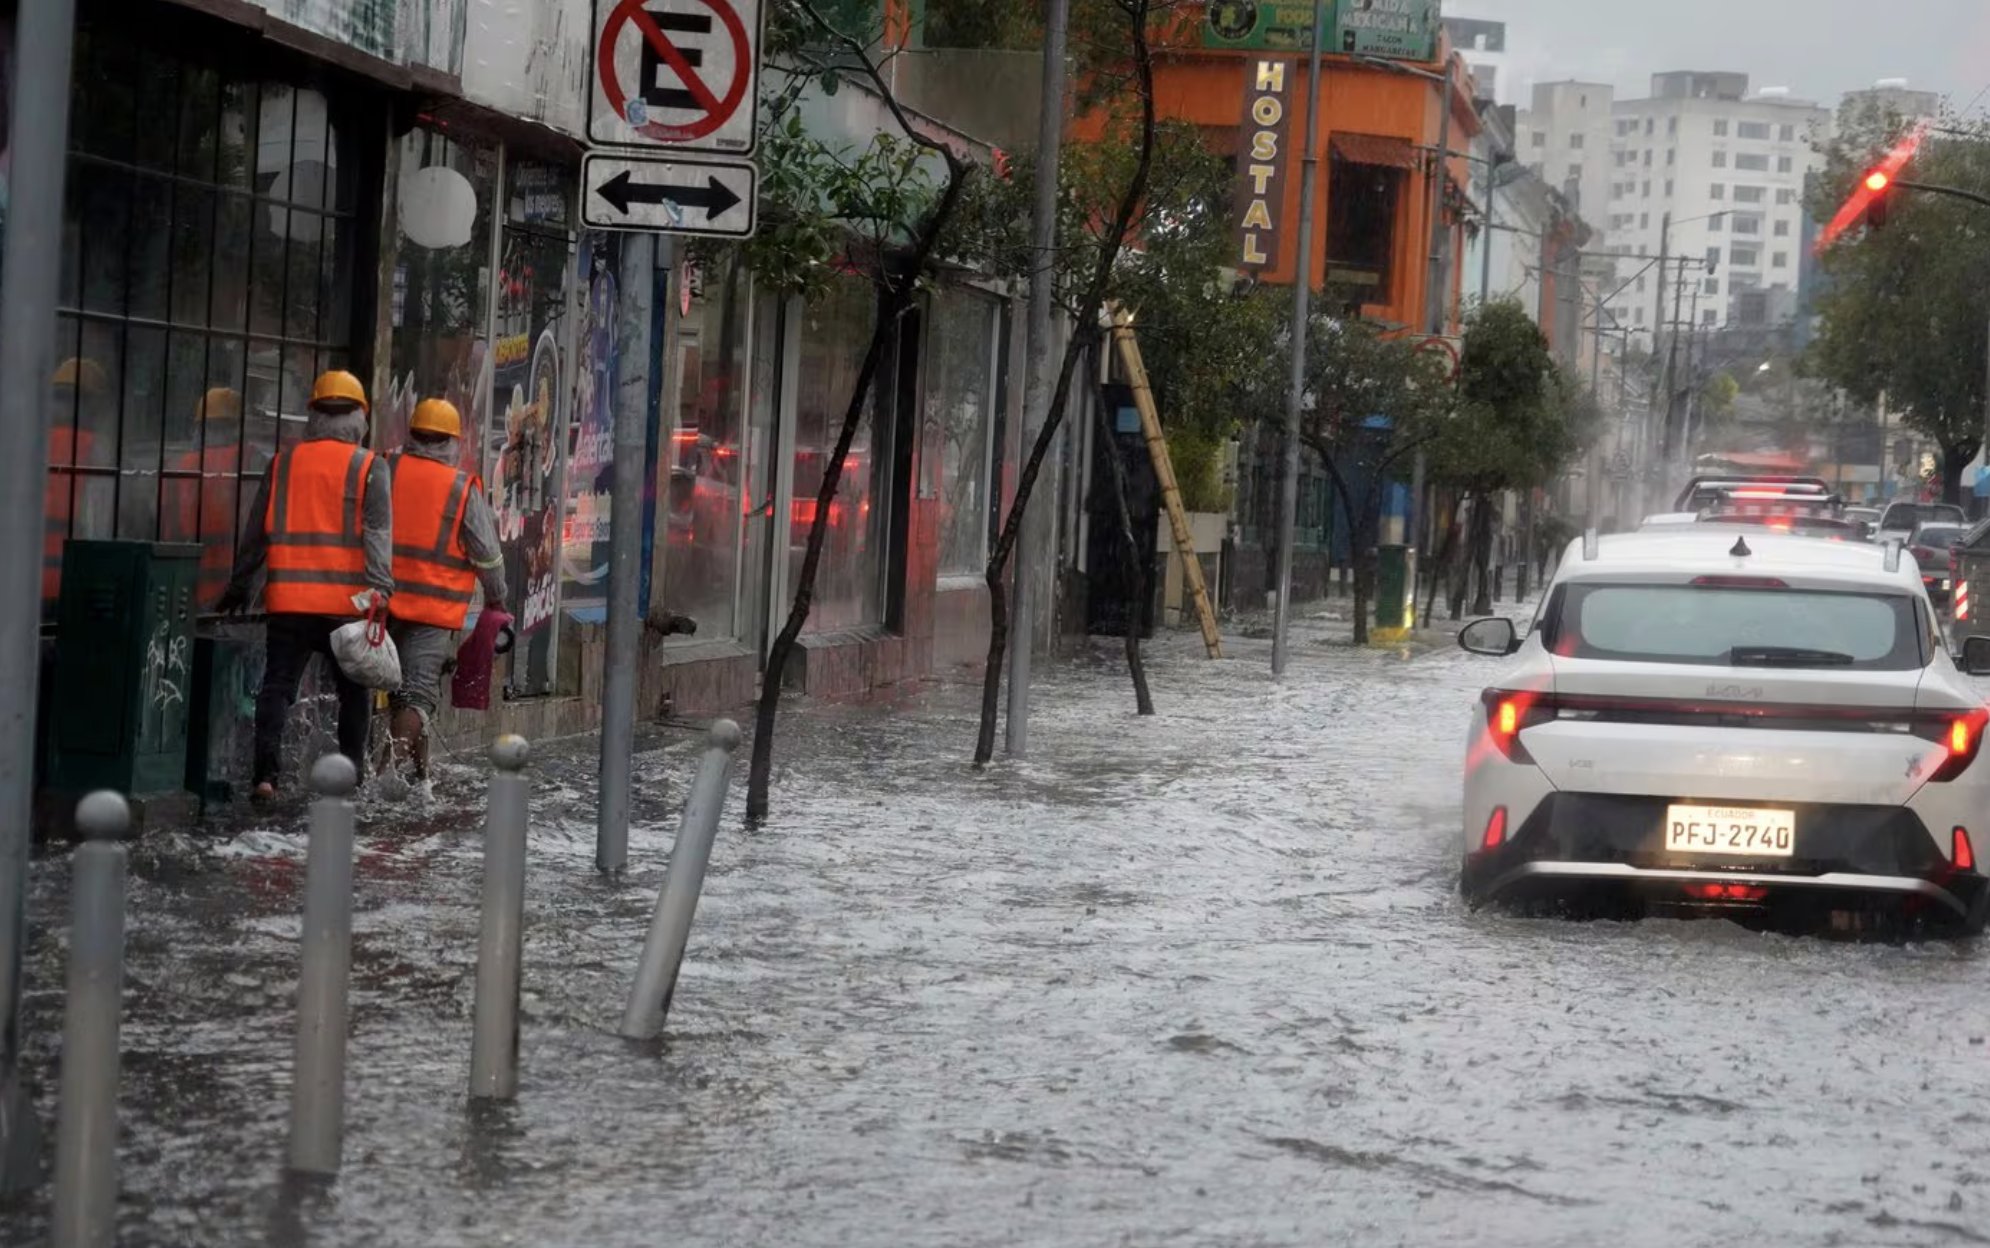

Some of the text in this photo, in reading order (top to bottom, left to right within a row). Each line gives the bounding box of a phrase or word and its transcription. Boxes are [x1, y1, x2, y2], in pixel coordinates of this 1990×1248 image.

[1340, 13, 1418, 33] MEXICANA
[640, 11, 711, 110] E
[1240, 61, 1285, 265] HOSTAL
[1672, 821, 1790, 849] PFJ-2740
